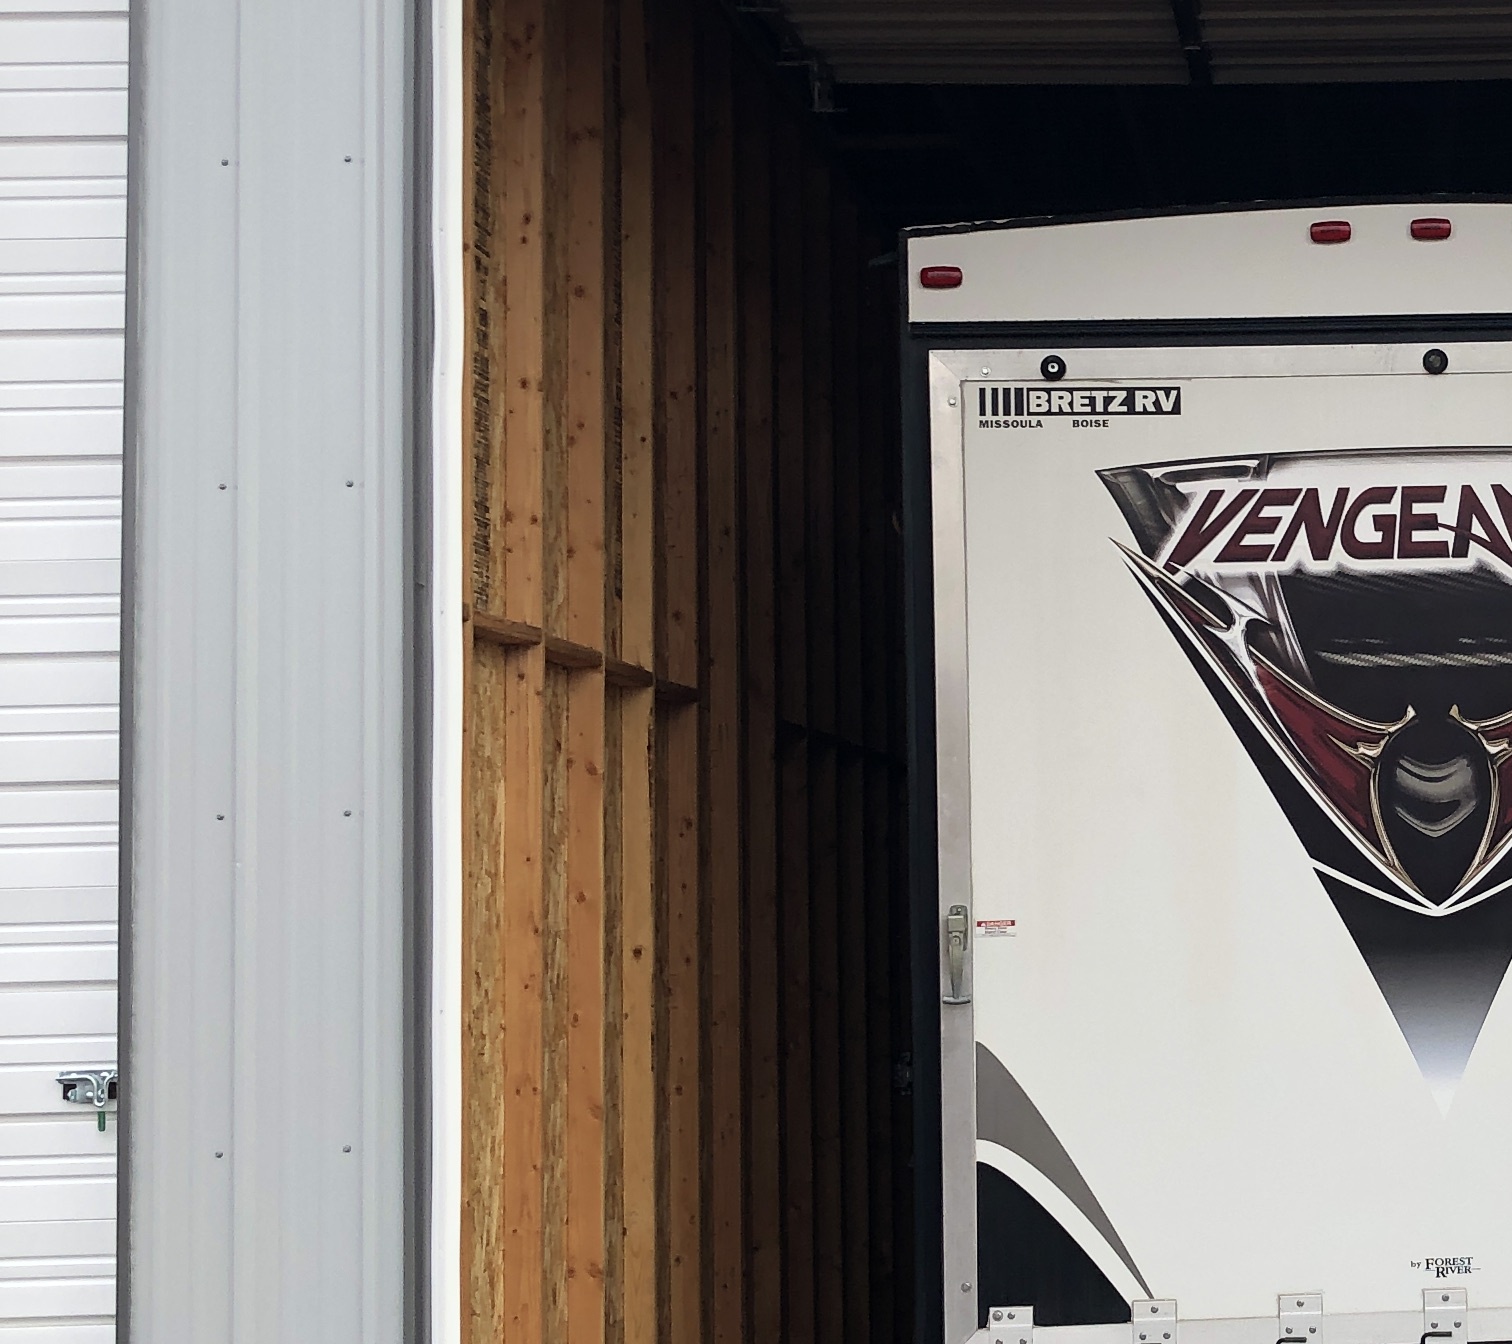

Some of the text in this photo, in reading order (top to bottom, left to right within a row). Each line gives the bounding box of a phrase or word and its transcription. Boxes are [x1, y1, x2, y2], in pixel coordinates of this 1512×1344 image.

[1028, 389, 1178, 413] BRETZ RV
[978, 419, 1110, 429] MISSOULA BOISE
[1410, 1257, 1474, 1270] by FOREST
[1435, 1266, 1473, 1278] RIVER
